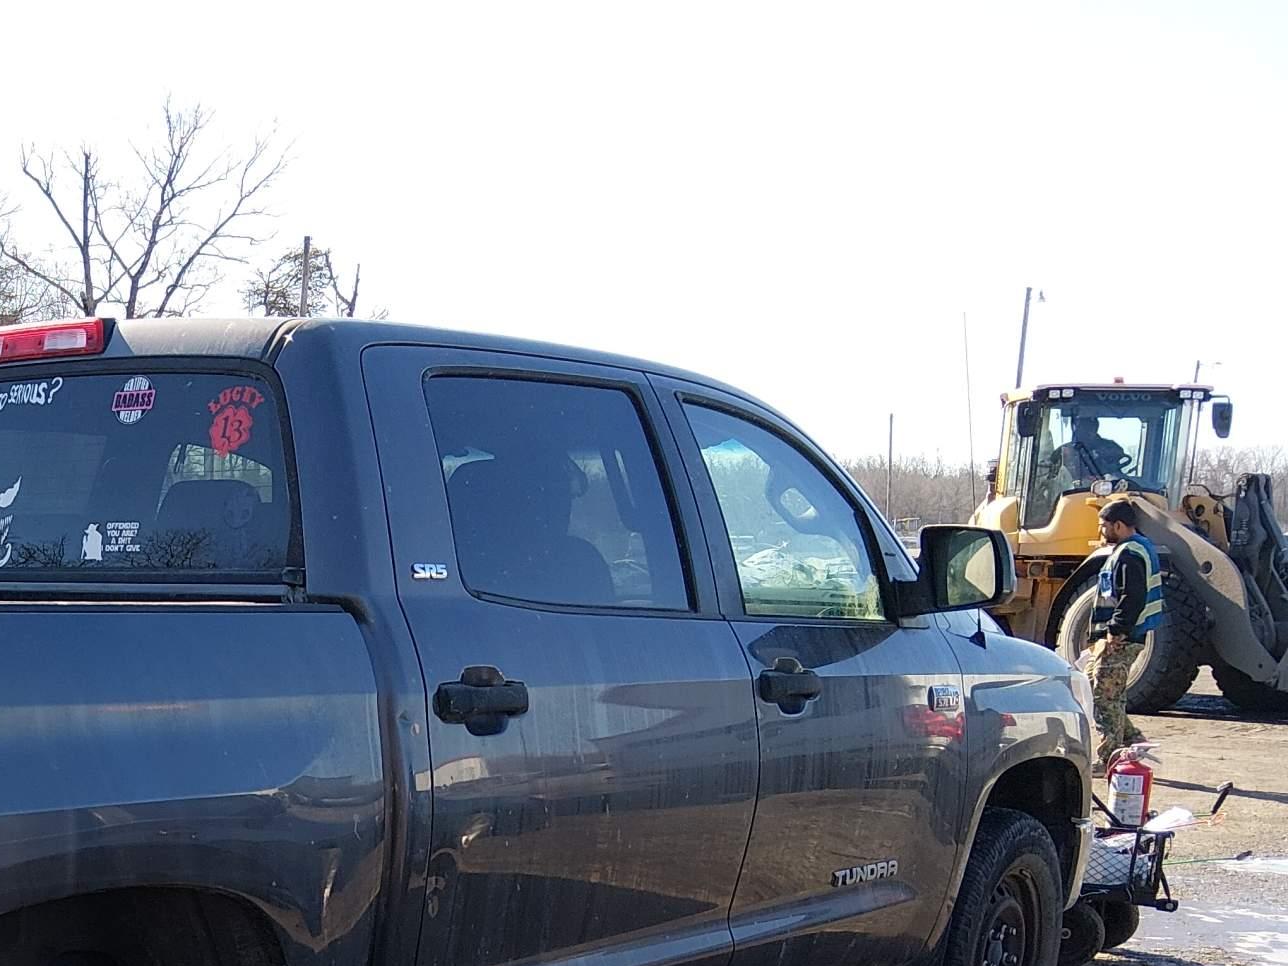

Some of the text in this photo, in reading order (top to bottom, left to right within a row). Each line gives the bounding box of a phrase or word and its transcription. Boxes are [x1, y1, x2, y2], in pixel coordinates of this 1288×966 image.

[8, 377, 63, 405] SERIOUS?
[1095, 392, 1152, 401] VOLVO
[114, 392, 153, 409] BADASS
[221, 415, 243, 443] 13
[110, 537, 116, 545] A
[413, 563, 448, 579] SR5
[833, 860, 899, 888] TUNDRA
